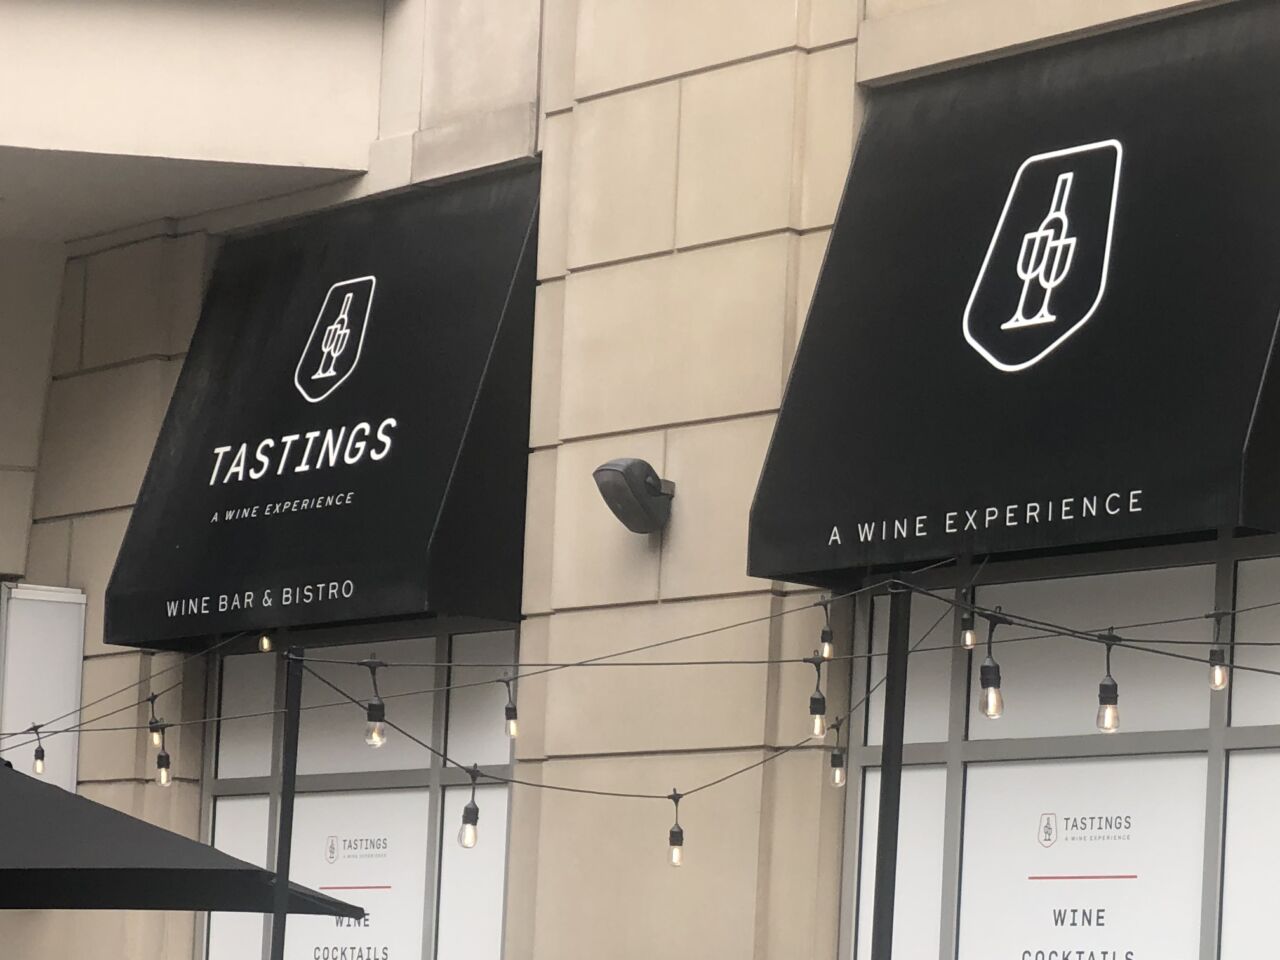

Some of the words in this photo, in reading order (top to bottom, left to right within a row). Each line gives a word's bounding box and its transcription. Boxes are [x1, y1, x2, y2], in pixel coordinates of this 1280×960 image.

[208, 417, 398, 486] TASTINGS
[210, 511, 219, 523] A
[224, 505, 260, 521] WINE
[264, 491, 355, 516] EXPERIENCE
[827, 525, 842, 546] A
[857, 515, 928, 543] WINE
[945, 489, 1144, 533] EXPERIENCE
[166, 596, 210, 617] WINE
[218, 591, 254, 612] BAR
[262, 589, 273, 607] &
[281, 579, 354, 606] BISTRO
[1064, 815, 1132, 831] TASTINGS
[342, 838, 388, 851] TASTINGS
[1053, 908, 1106, 927] WINE
[313, 946, 389, 960] COCKTAILS
